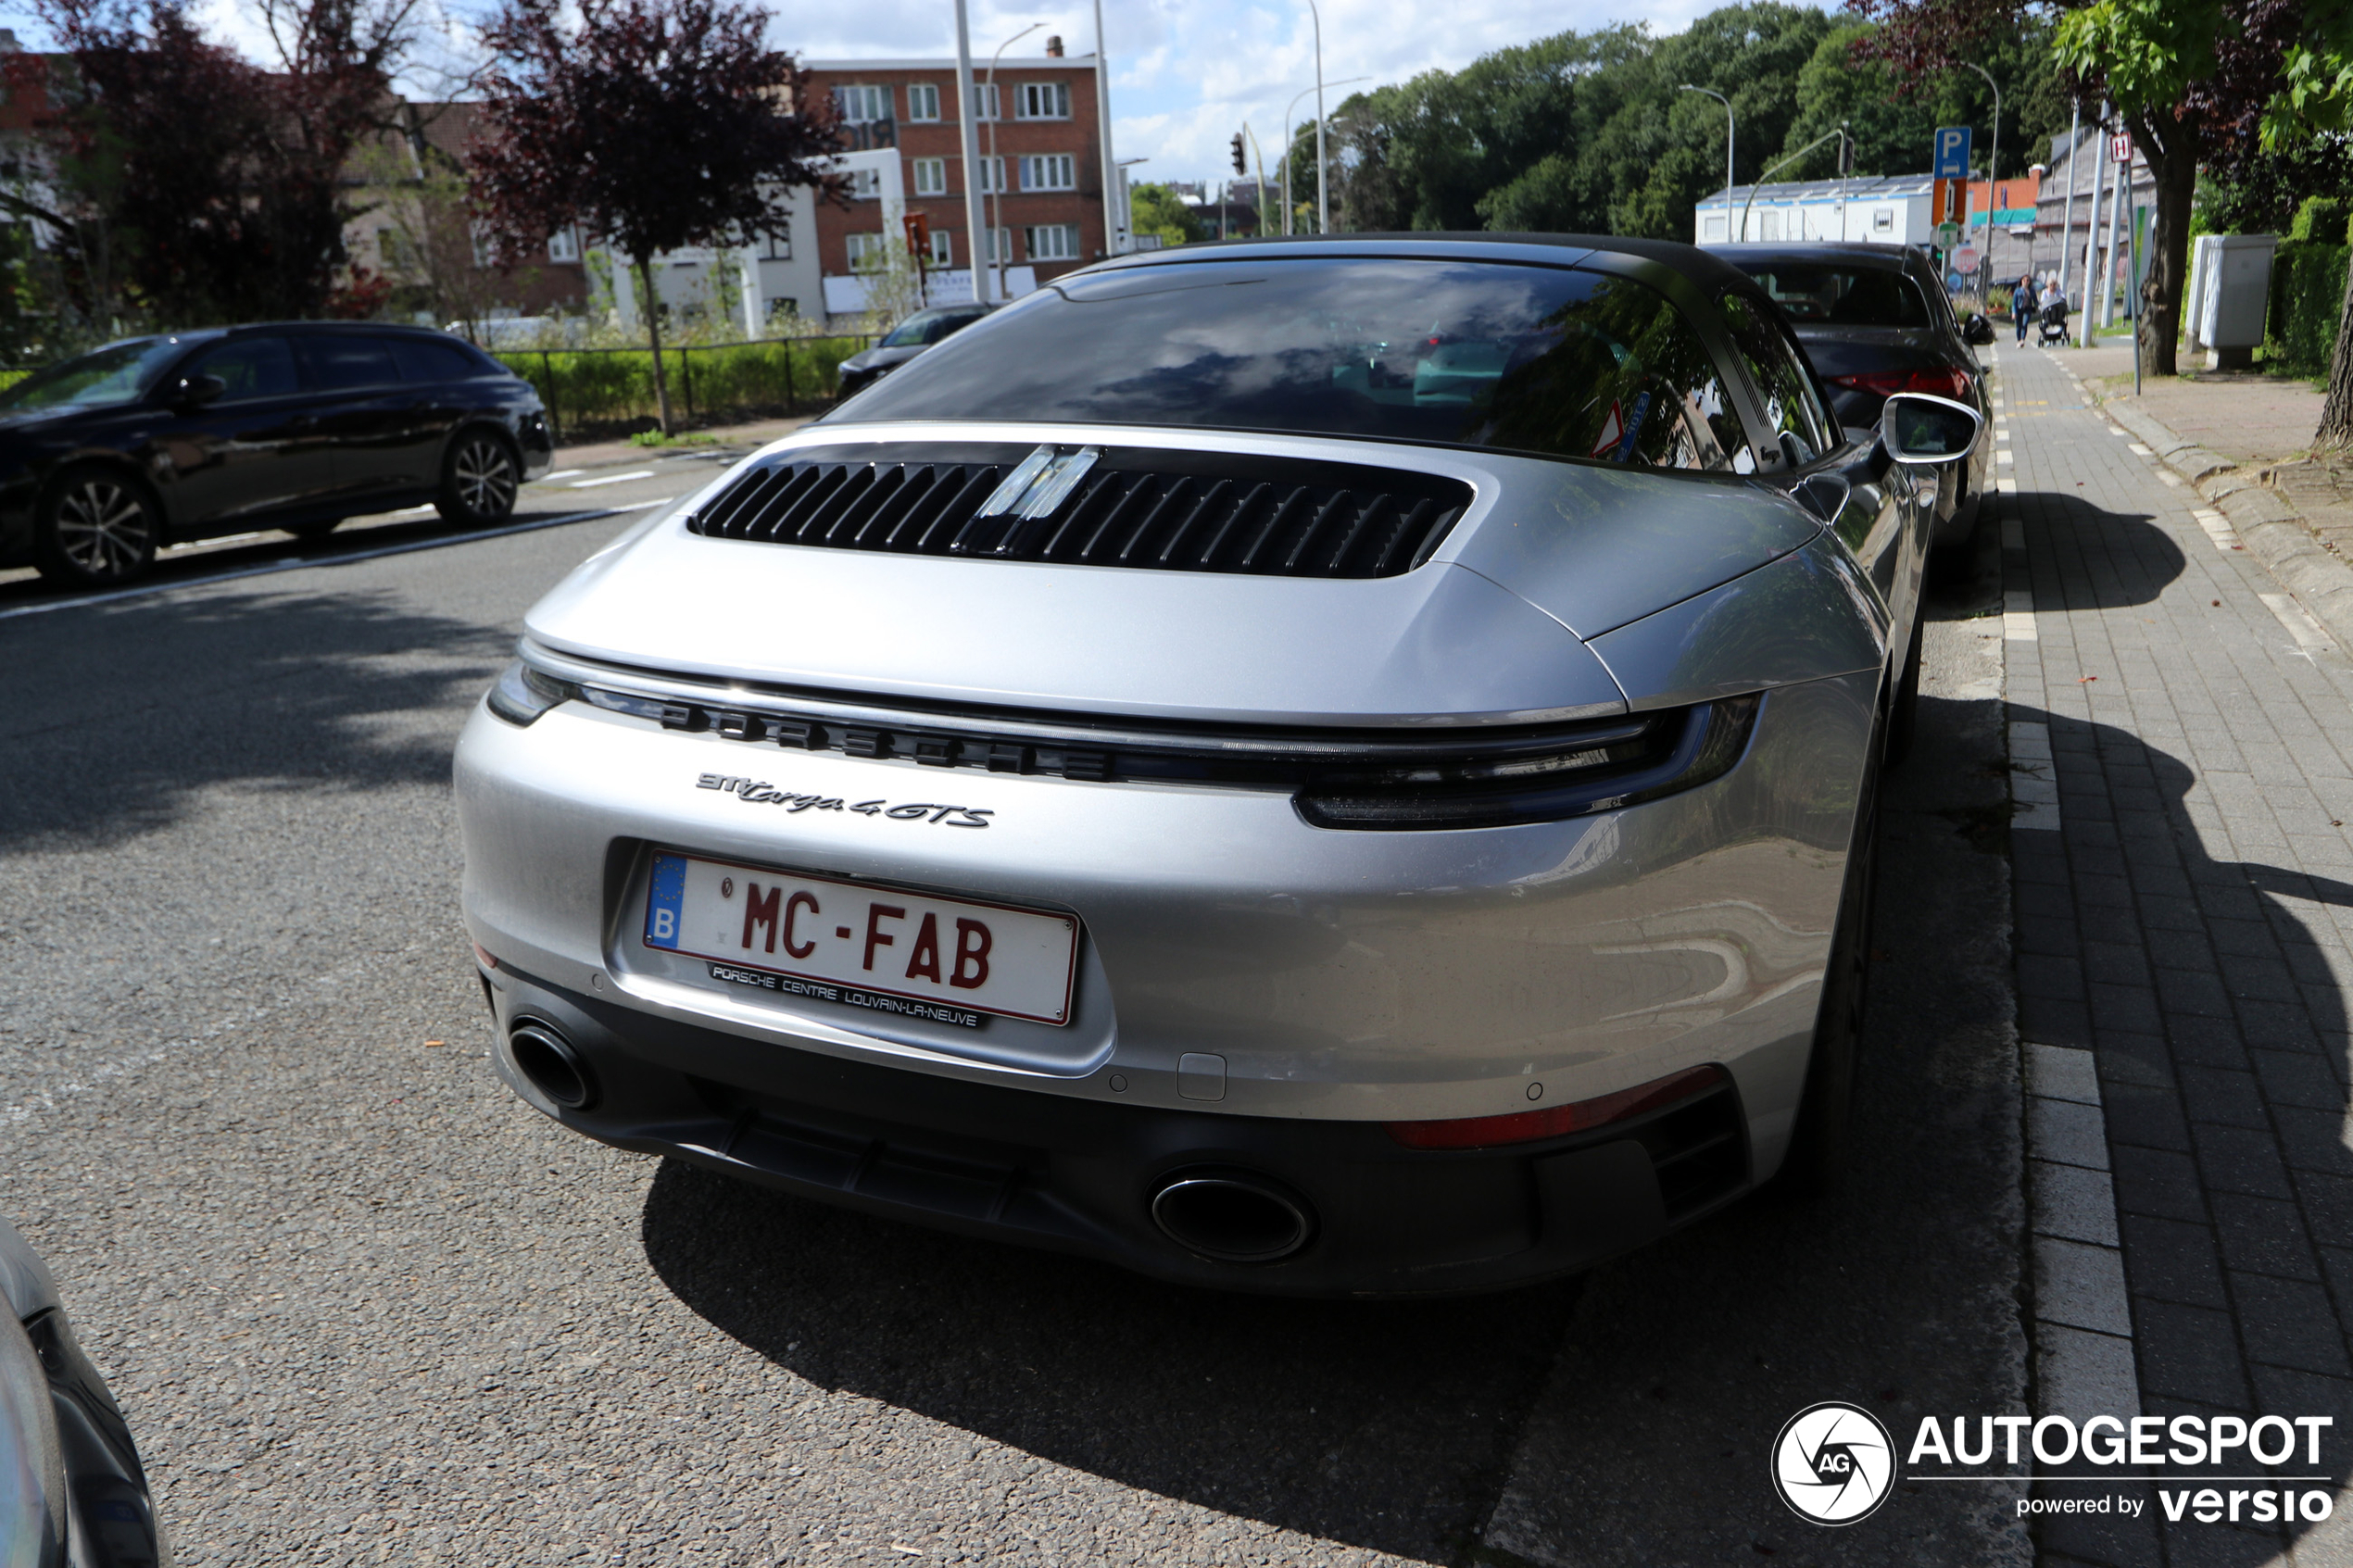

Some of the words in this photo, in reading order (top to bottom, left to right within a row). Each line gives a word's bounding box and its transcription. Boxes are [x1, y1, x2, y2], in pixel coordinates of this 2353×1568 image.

[1943, 132, 1962, 158] P
[2115, 139, 2126, 157] H
[661, 704, 1109, 782] PORSCHE
[849, 799, 887, 815] 4
[885, 803, 994, 827] GTS
[653, 908, 675, 939] B
[712, 966, 776, 988] PORSCHE
[782, 979, 838, 1000] CENTRE
[844, 991, 977, 1027] LOUVAIN-LA-NEUVE
